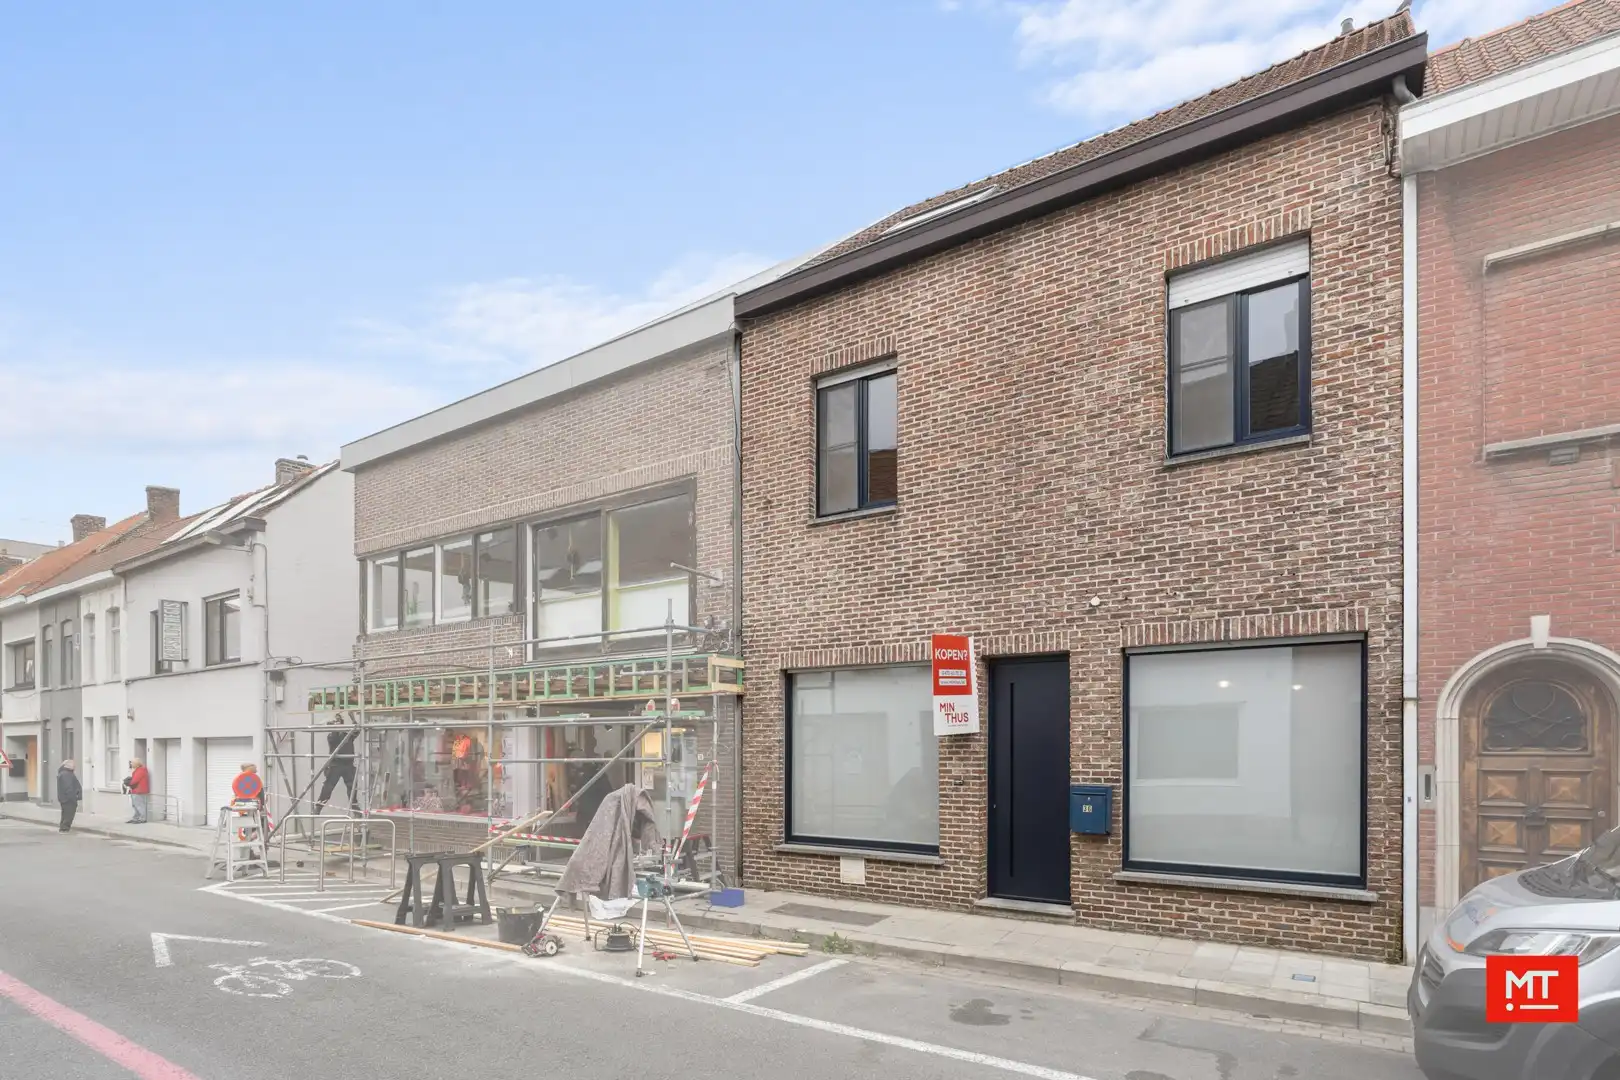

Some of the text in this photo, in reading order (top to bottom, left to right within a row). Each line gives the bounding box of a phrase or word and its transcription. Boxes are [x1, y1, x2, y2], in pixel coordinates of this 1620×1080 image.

[934, 648, 968, 661] KOPEN?
[939, 702, 955, 713] MIN
[945, 712, 969, 724] THUS
